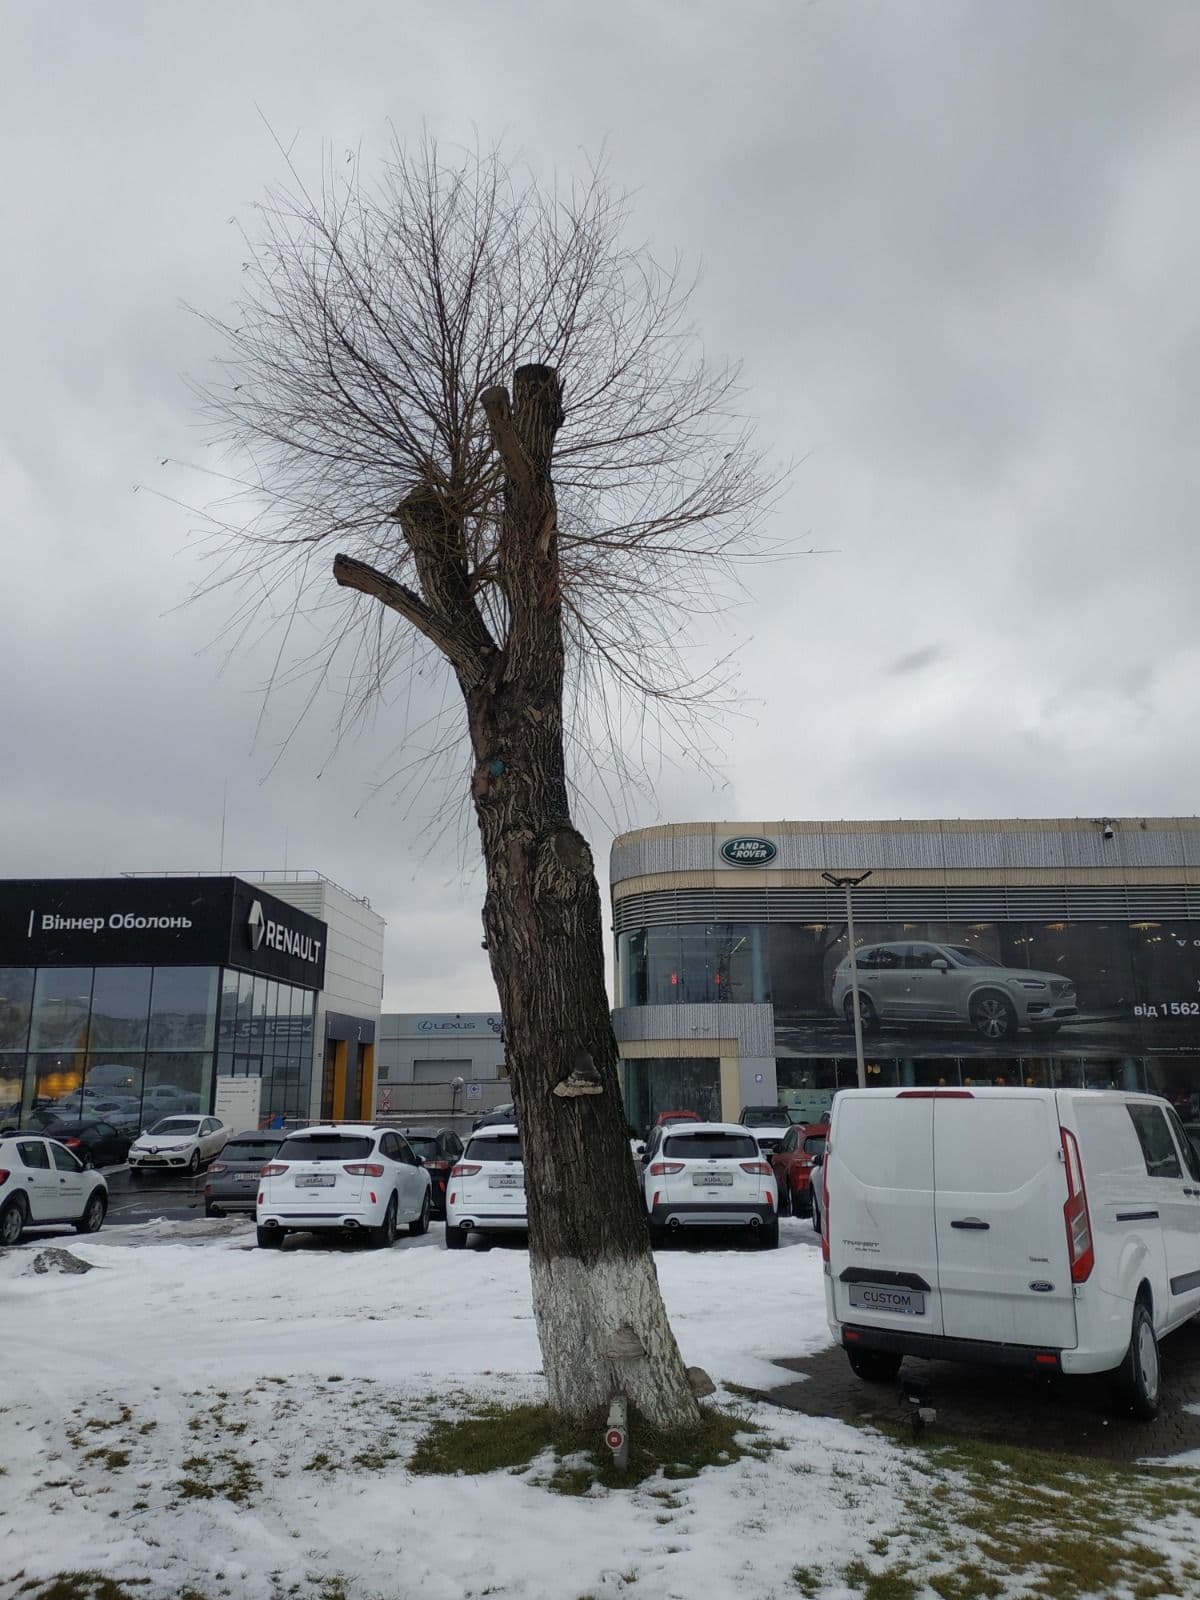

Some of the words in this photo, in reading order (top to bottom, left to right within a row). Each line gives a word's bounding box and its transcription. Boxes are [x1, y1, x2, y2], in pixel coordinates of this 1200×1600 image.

[733, 842, 760, 850] LAND
[735, 850, 768, 858] ROVER
[42, 914, 105, 933] Віннер
[109, 913, 192, 930] Оболонь
[265, 920, 321, 965] RENAULT
[1134, 1003, 1158, 1018] від
[434, 1022, 476, 1030] LEXUS
[863, 1290, 912, 1306] CUSTOM
